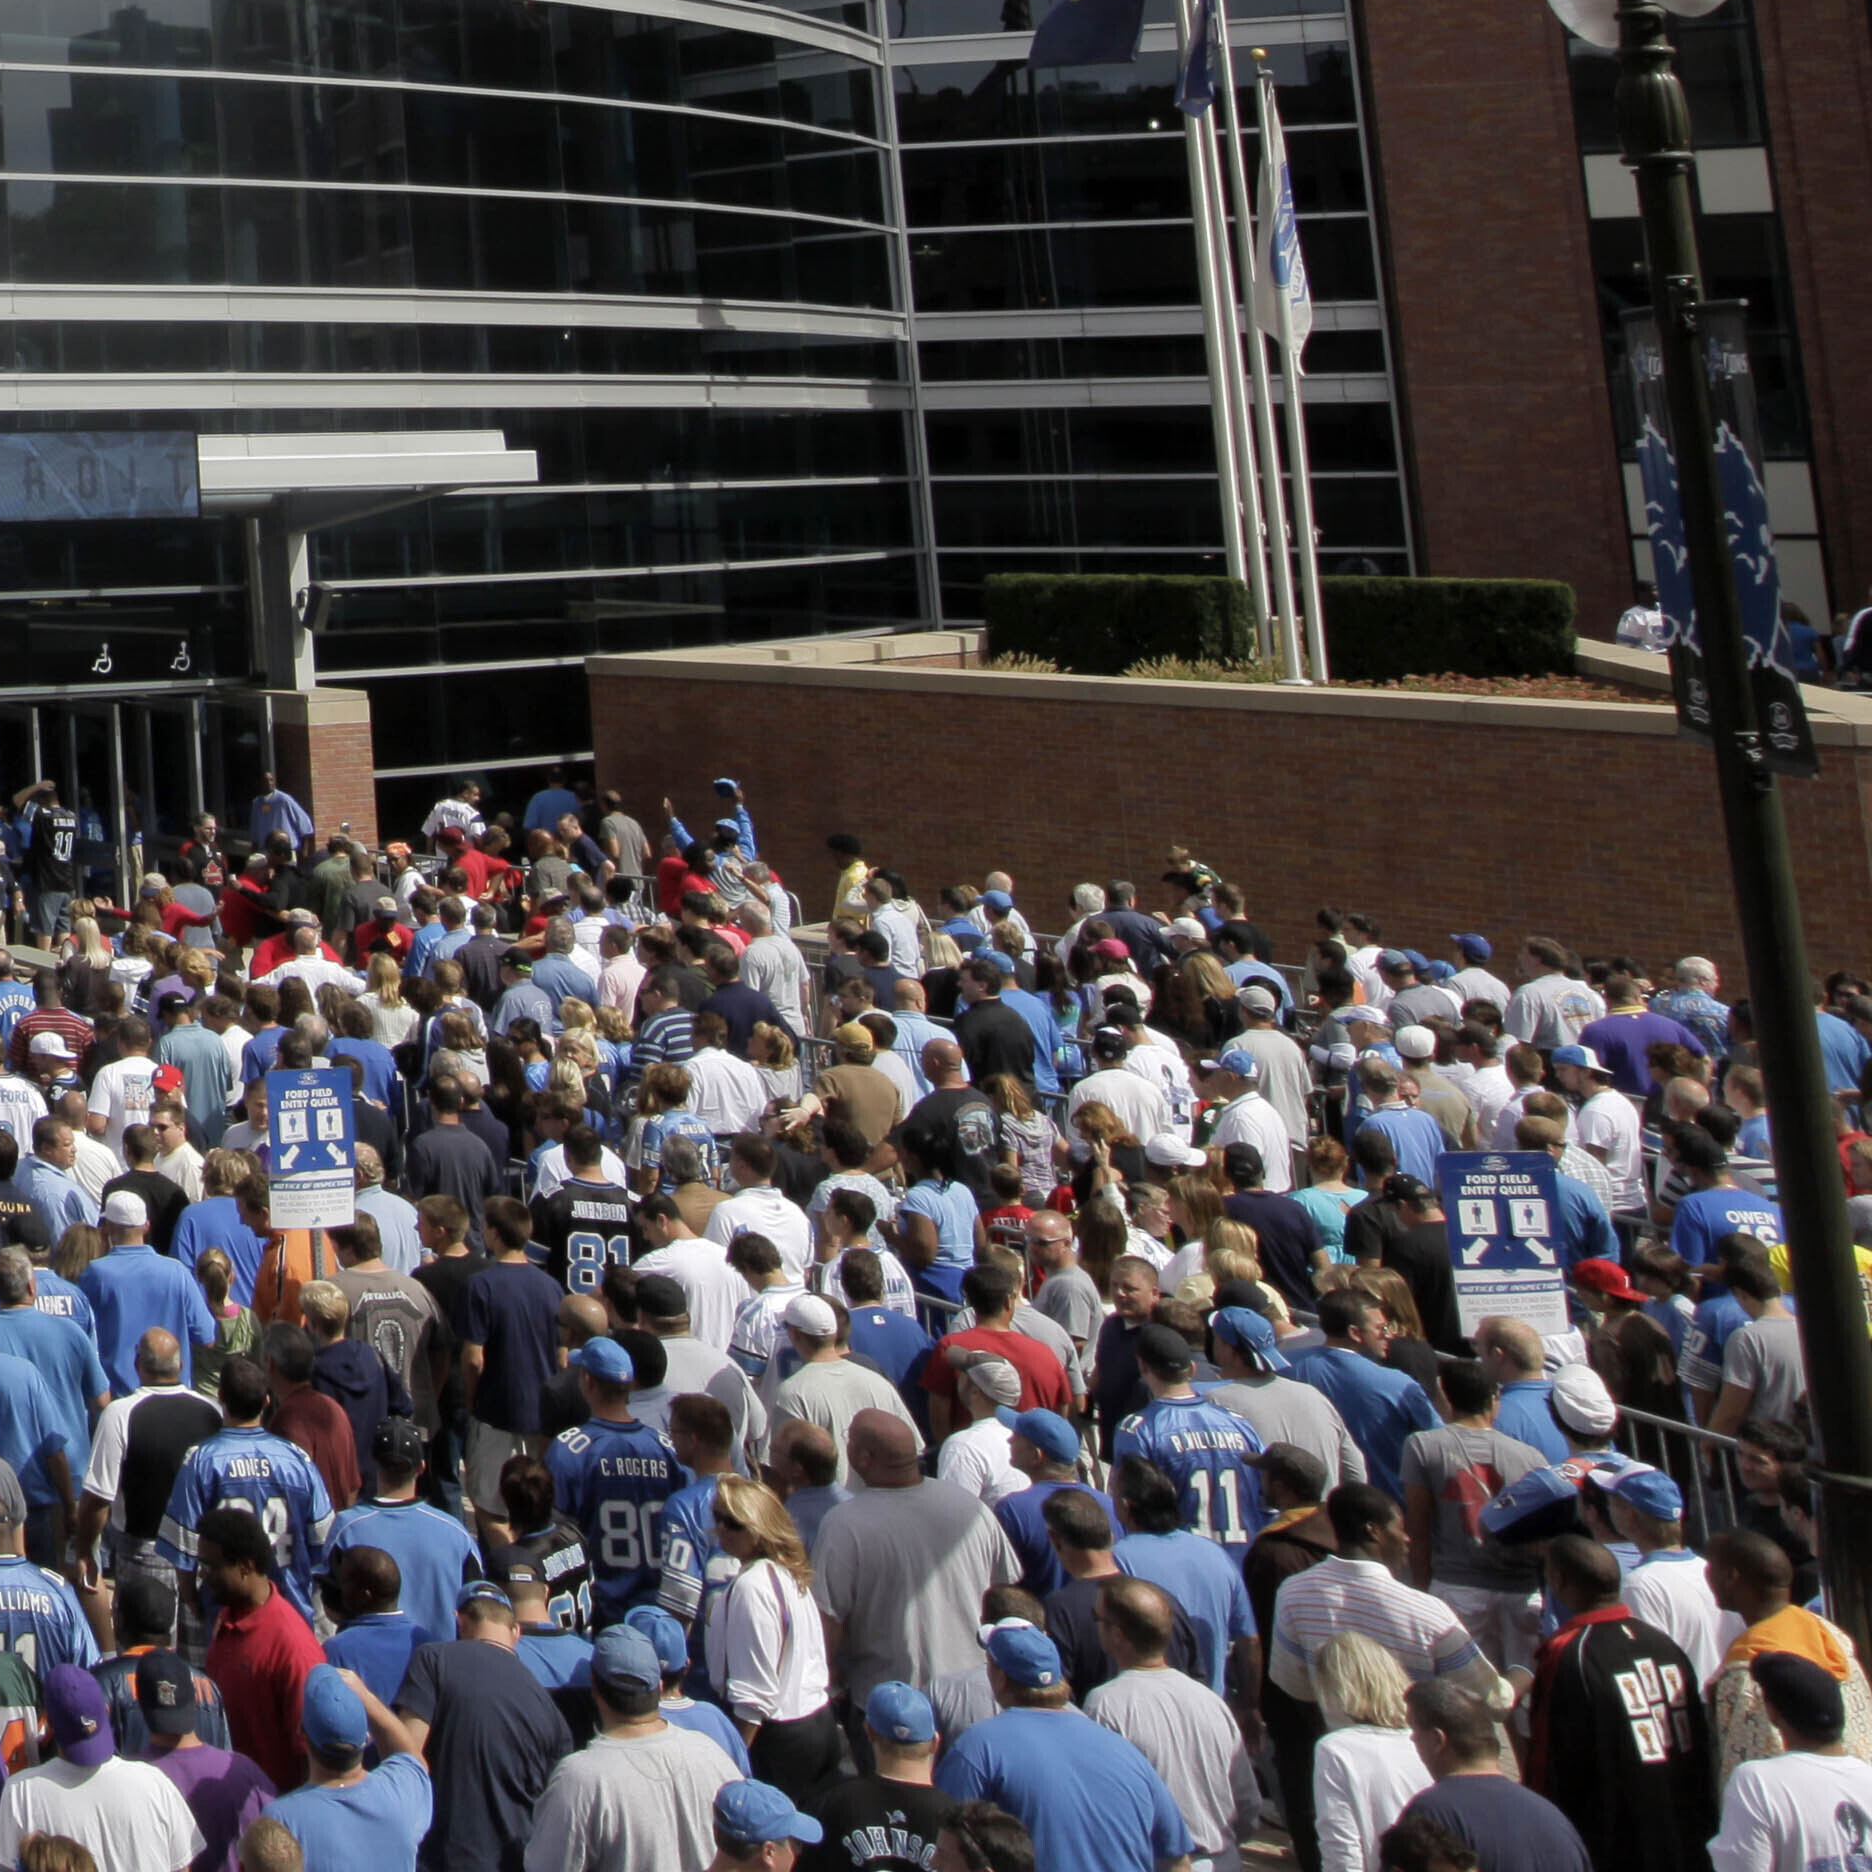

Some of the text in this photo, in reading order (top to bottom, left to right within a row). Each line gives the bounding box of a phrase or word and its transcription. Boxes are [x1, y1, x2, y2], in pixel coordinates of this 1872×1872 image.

[280, 1097, 338, 1108] ENTRY QUEUE
[286, 1088, 332, 1098] FORD FIELD
[1460, 1185, 1538, 1195] ENTRY QUEUE
[1465, 1174, 1531, 1185] FORD FIELD
[571, 1200, 628, 1222] JOHNSON
[1725, 1209, 1776, 1226] OWEN
[566, 1230, 631, 1296] 81
[362, 1289, 407, 1303] METALLICA
[557, 1427, 591, 1453] 80
[229, 1458, 271, 1480] JONES
[600, 1456, 669, 1481] C.ROGERS
[1190, 1468, 1248, 1544] 11
[599, 1499, 668, 1570] 80
[841, 1825, 937, 1867] JOHNS
